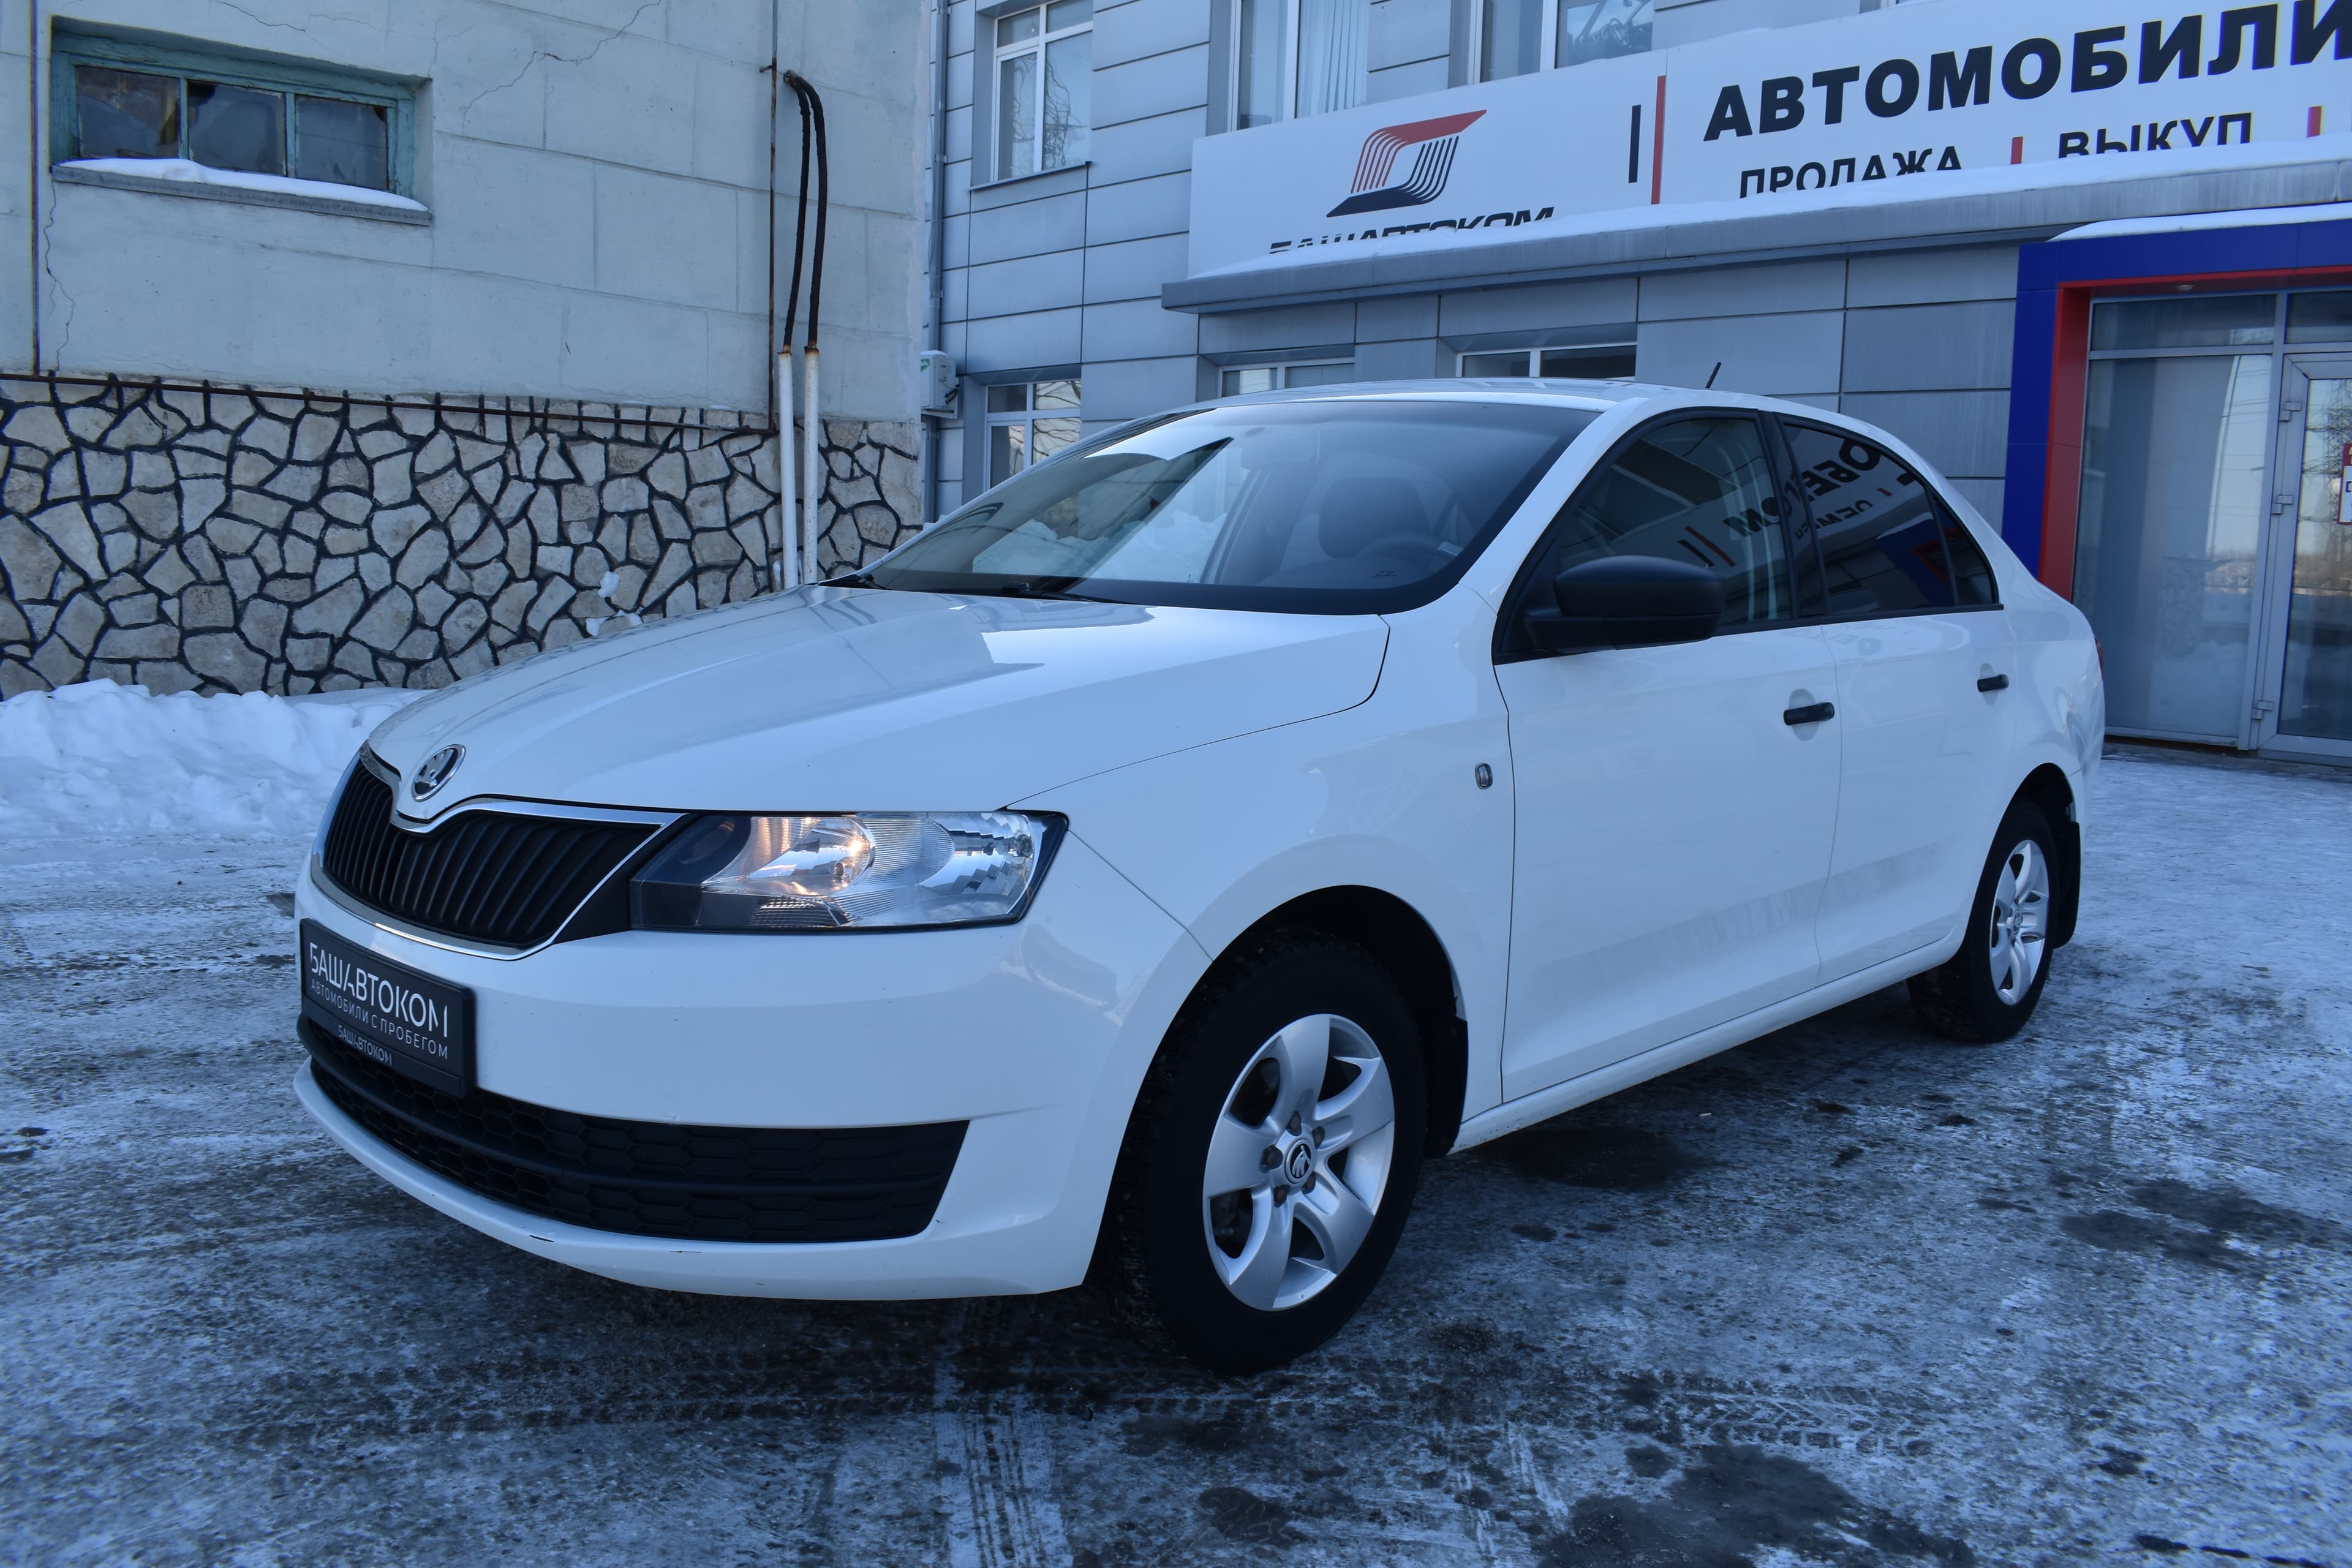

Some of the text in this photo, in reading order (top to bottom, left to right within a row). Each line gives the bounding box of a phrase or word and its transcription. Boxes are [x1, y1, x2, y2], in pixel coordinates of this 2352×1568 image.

[1703, 0, 2352, 141] АВТОМОБИЛИ
[2058, 112, 2252, 159] ВЫКУП
[309, 942, 448, 1038] БАШАВТОКОМ
[311, 978, 448, 1060] АВТОМОБИЛИ С ПРОБЕГОМ
[337, 1024, 392, 1066] БАШАВТОКОМ
